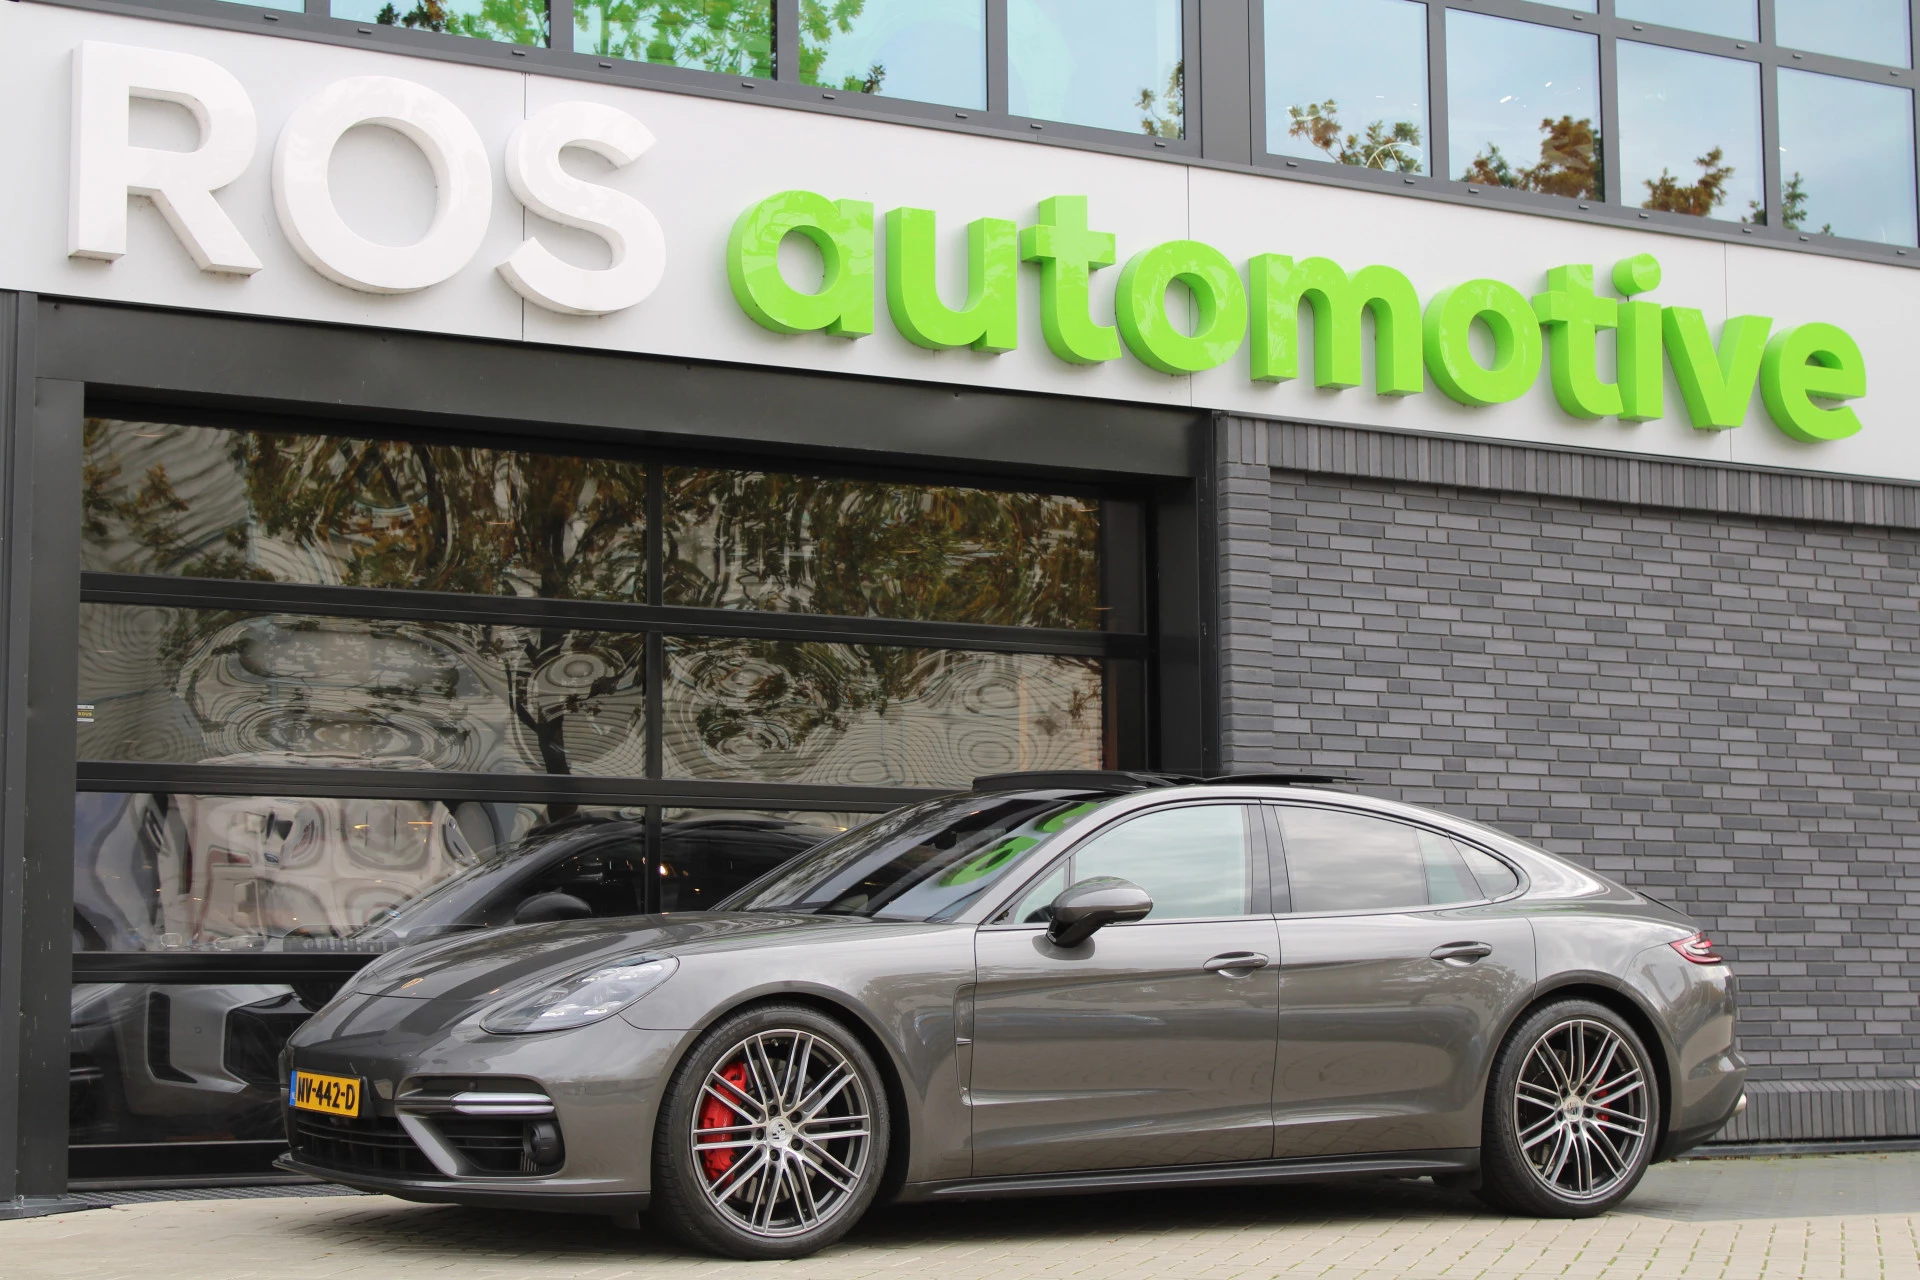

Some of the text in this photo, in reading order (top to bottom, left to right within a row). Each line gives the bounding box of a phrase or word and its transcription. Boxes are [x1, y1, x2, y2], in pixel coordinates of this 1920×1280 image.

[68, 40, 1867, 444] ROS automotive
[297, 1077, 356, 1110] NV-442-D
